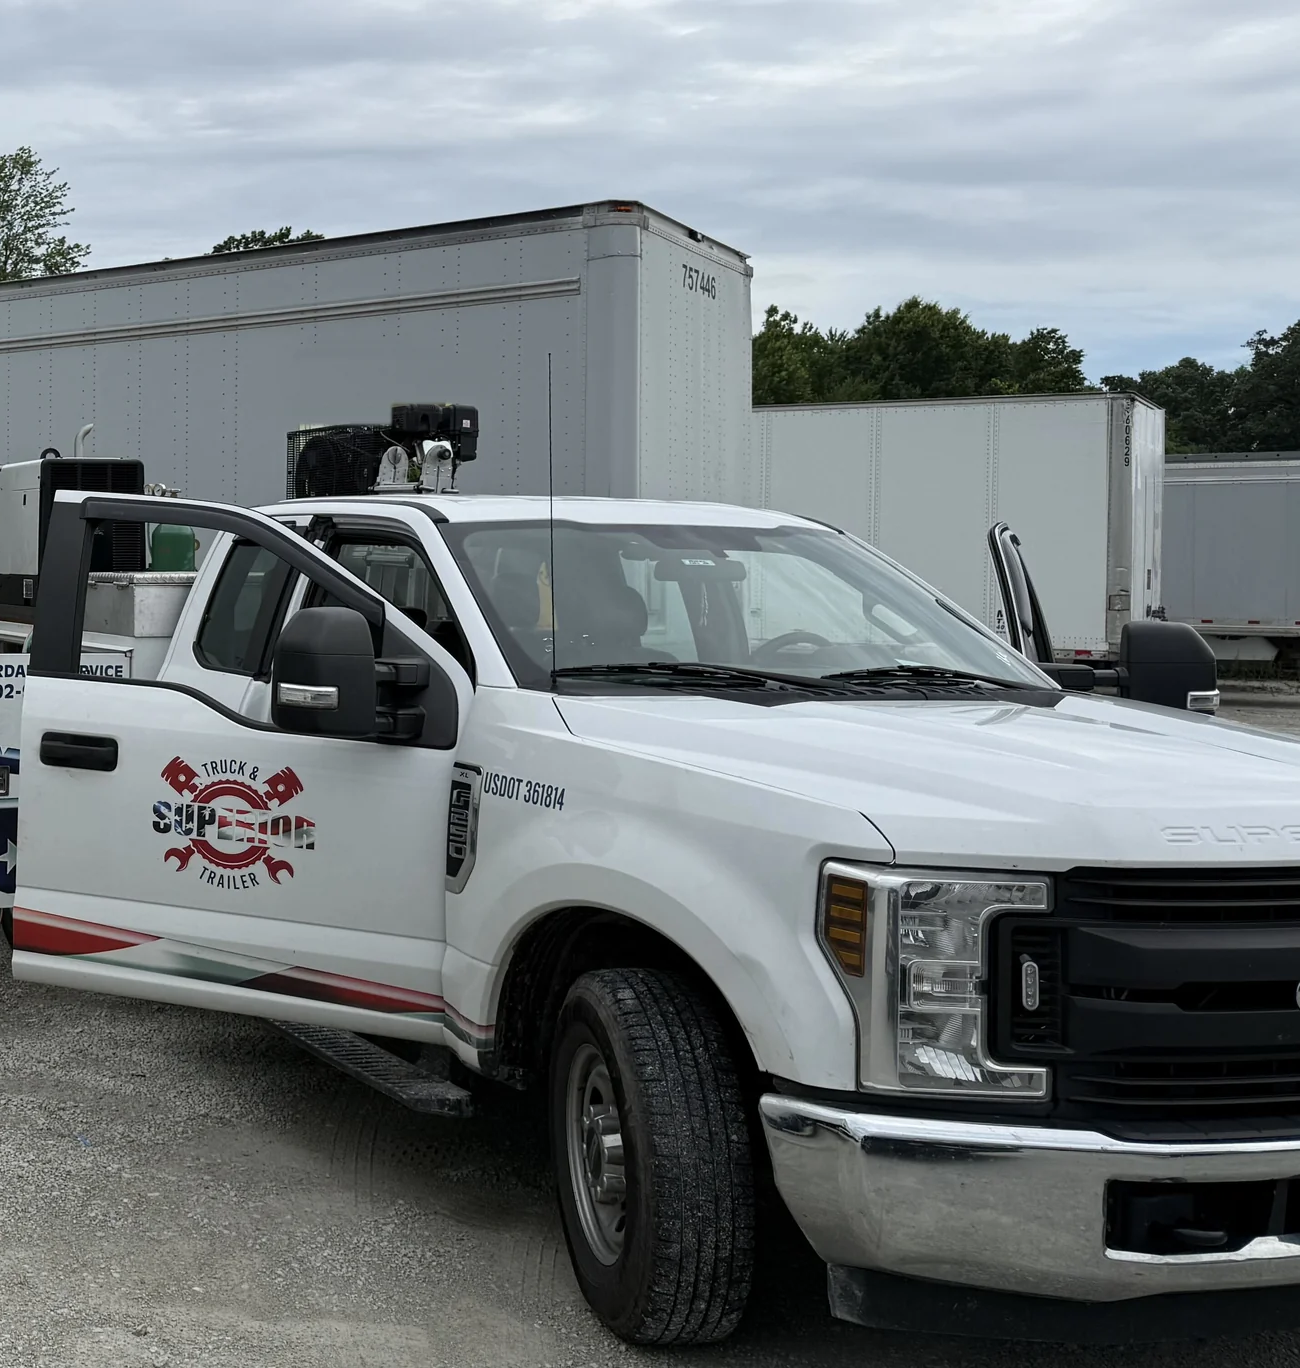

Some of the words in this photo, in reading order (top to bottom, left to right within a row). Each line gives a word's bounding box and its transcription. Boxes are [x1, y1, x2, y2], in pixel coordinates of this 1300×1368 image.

[682, 263, 716, 300] 757446
[201, 759, 247, 778] TRUCK
[249, 766, 259, 781] &
[459, 771, 469, 779] XL
[483, 771, 524, 801] USDOT
[523, 780, 566, 811] 361814
[152, 800, 316, 850] SUPERIOR
[199, 866, 260, 890] TRAILER
